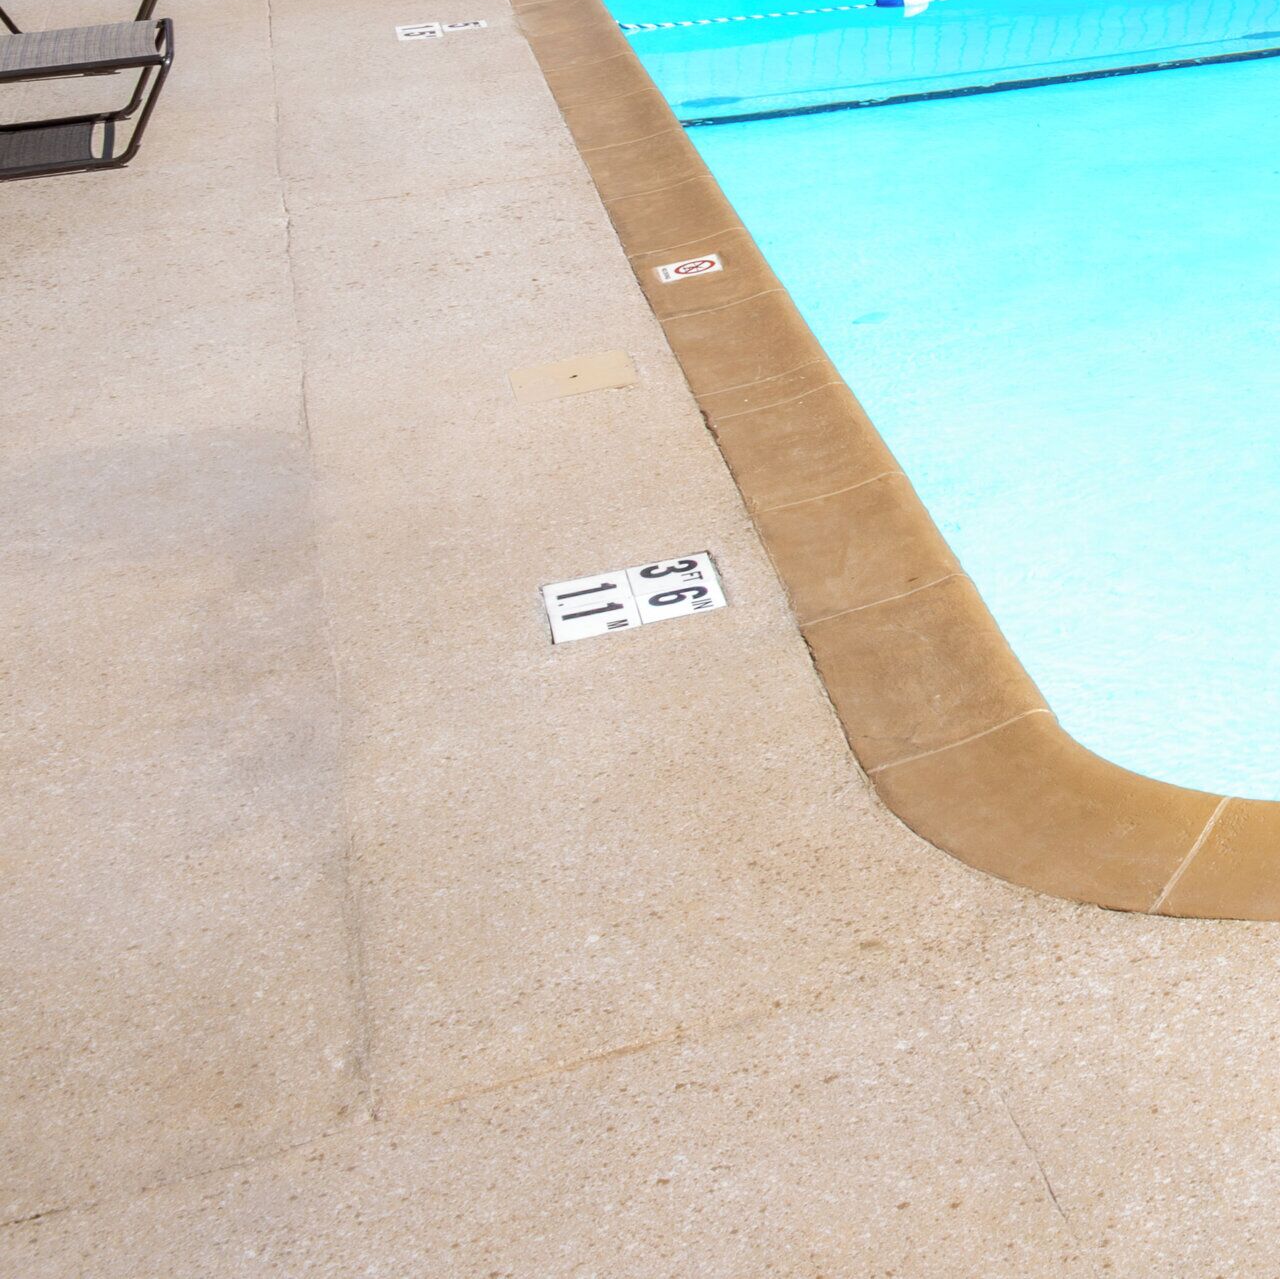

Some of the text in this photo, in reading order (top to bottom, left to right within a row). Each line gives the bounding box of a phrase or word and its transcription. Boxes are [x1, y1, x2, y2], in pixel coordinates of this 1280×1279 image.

[639, 560, 714, 610] 3 FT 6 IN
[606, 619, 629, 630] M
